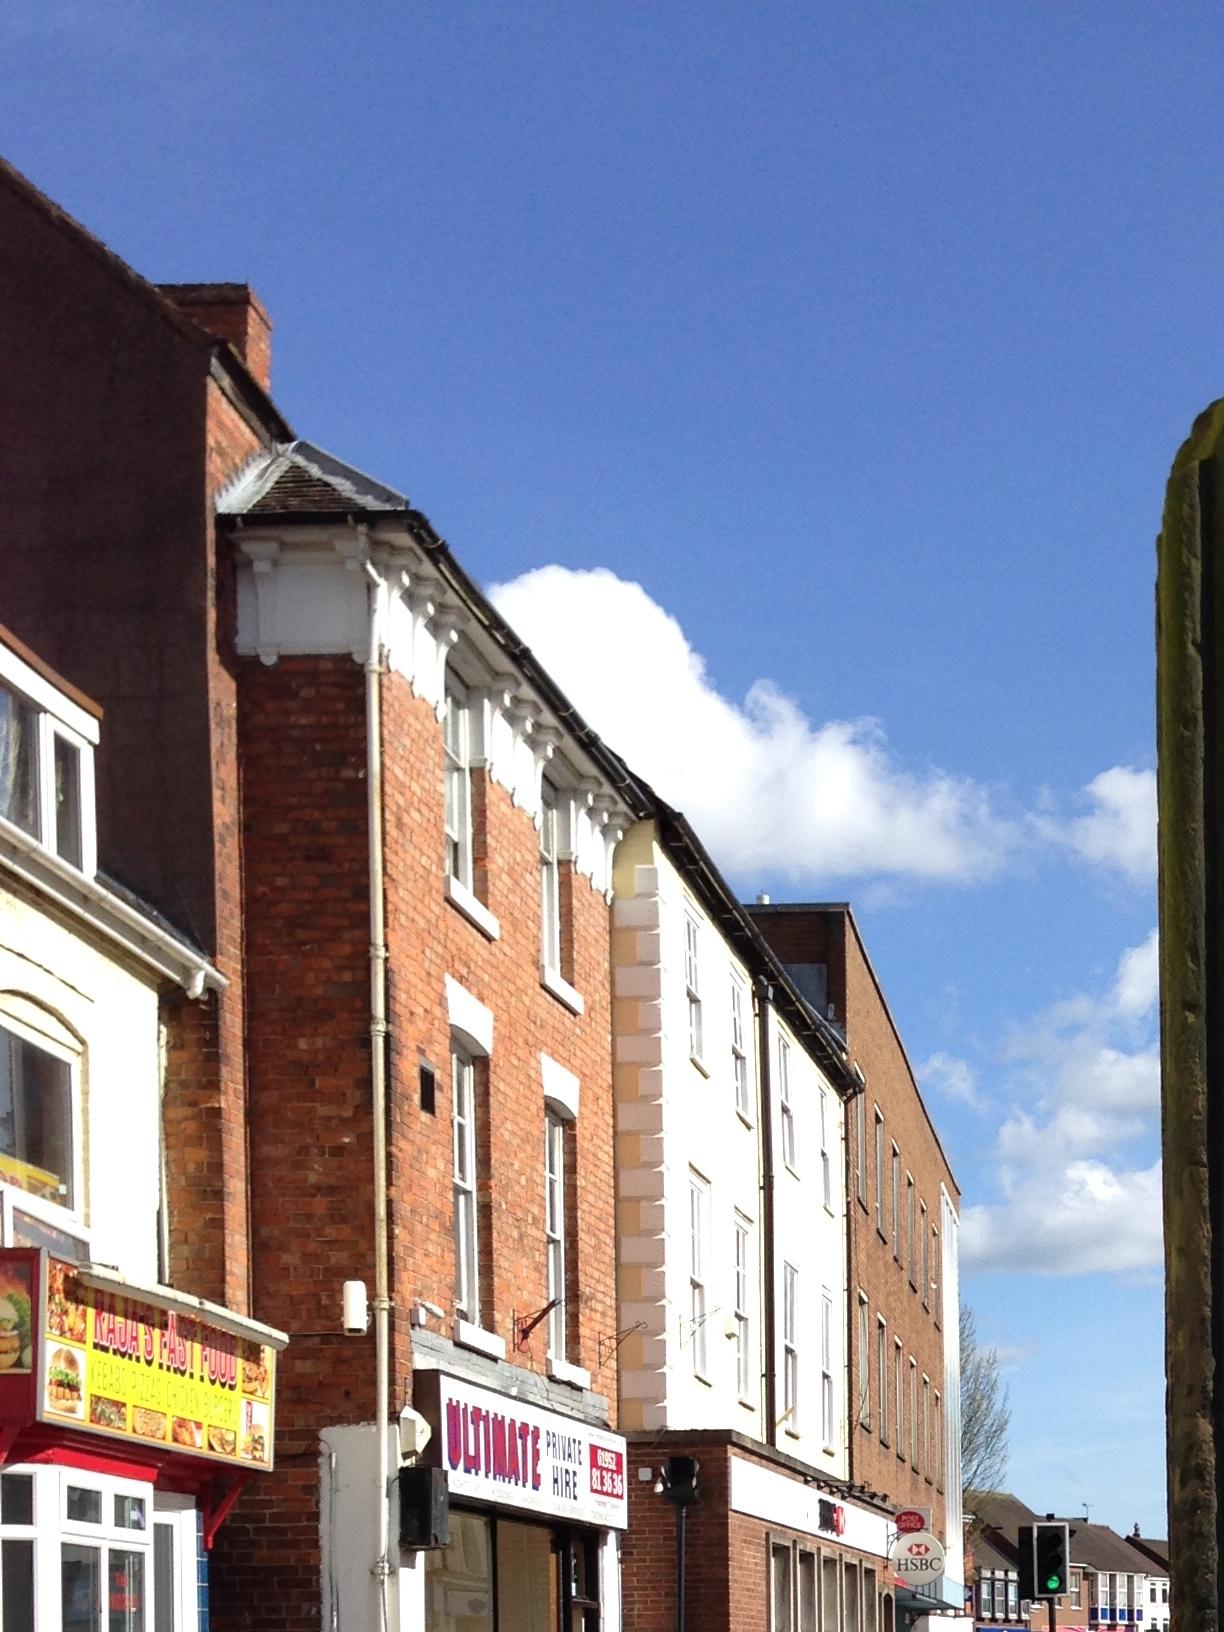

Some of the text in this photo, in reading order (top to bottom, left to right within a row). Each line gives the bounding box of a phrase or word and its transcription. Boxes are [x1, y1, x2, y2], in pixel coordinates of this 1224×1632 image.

[93, 1288, 238, 1391] RAJA'S FAST FOOD
[446, 1397, 541, 1491] ULTIMATE
[546, 1430, 583, 1466] PRIVATE
[552, 1465, 578, 1500] HIRE
[897, 1558, 941, 1571] HSBC
